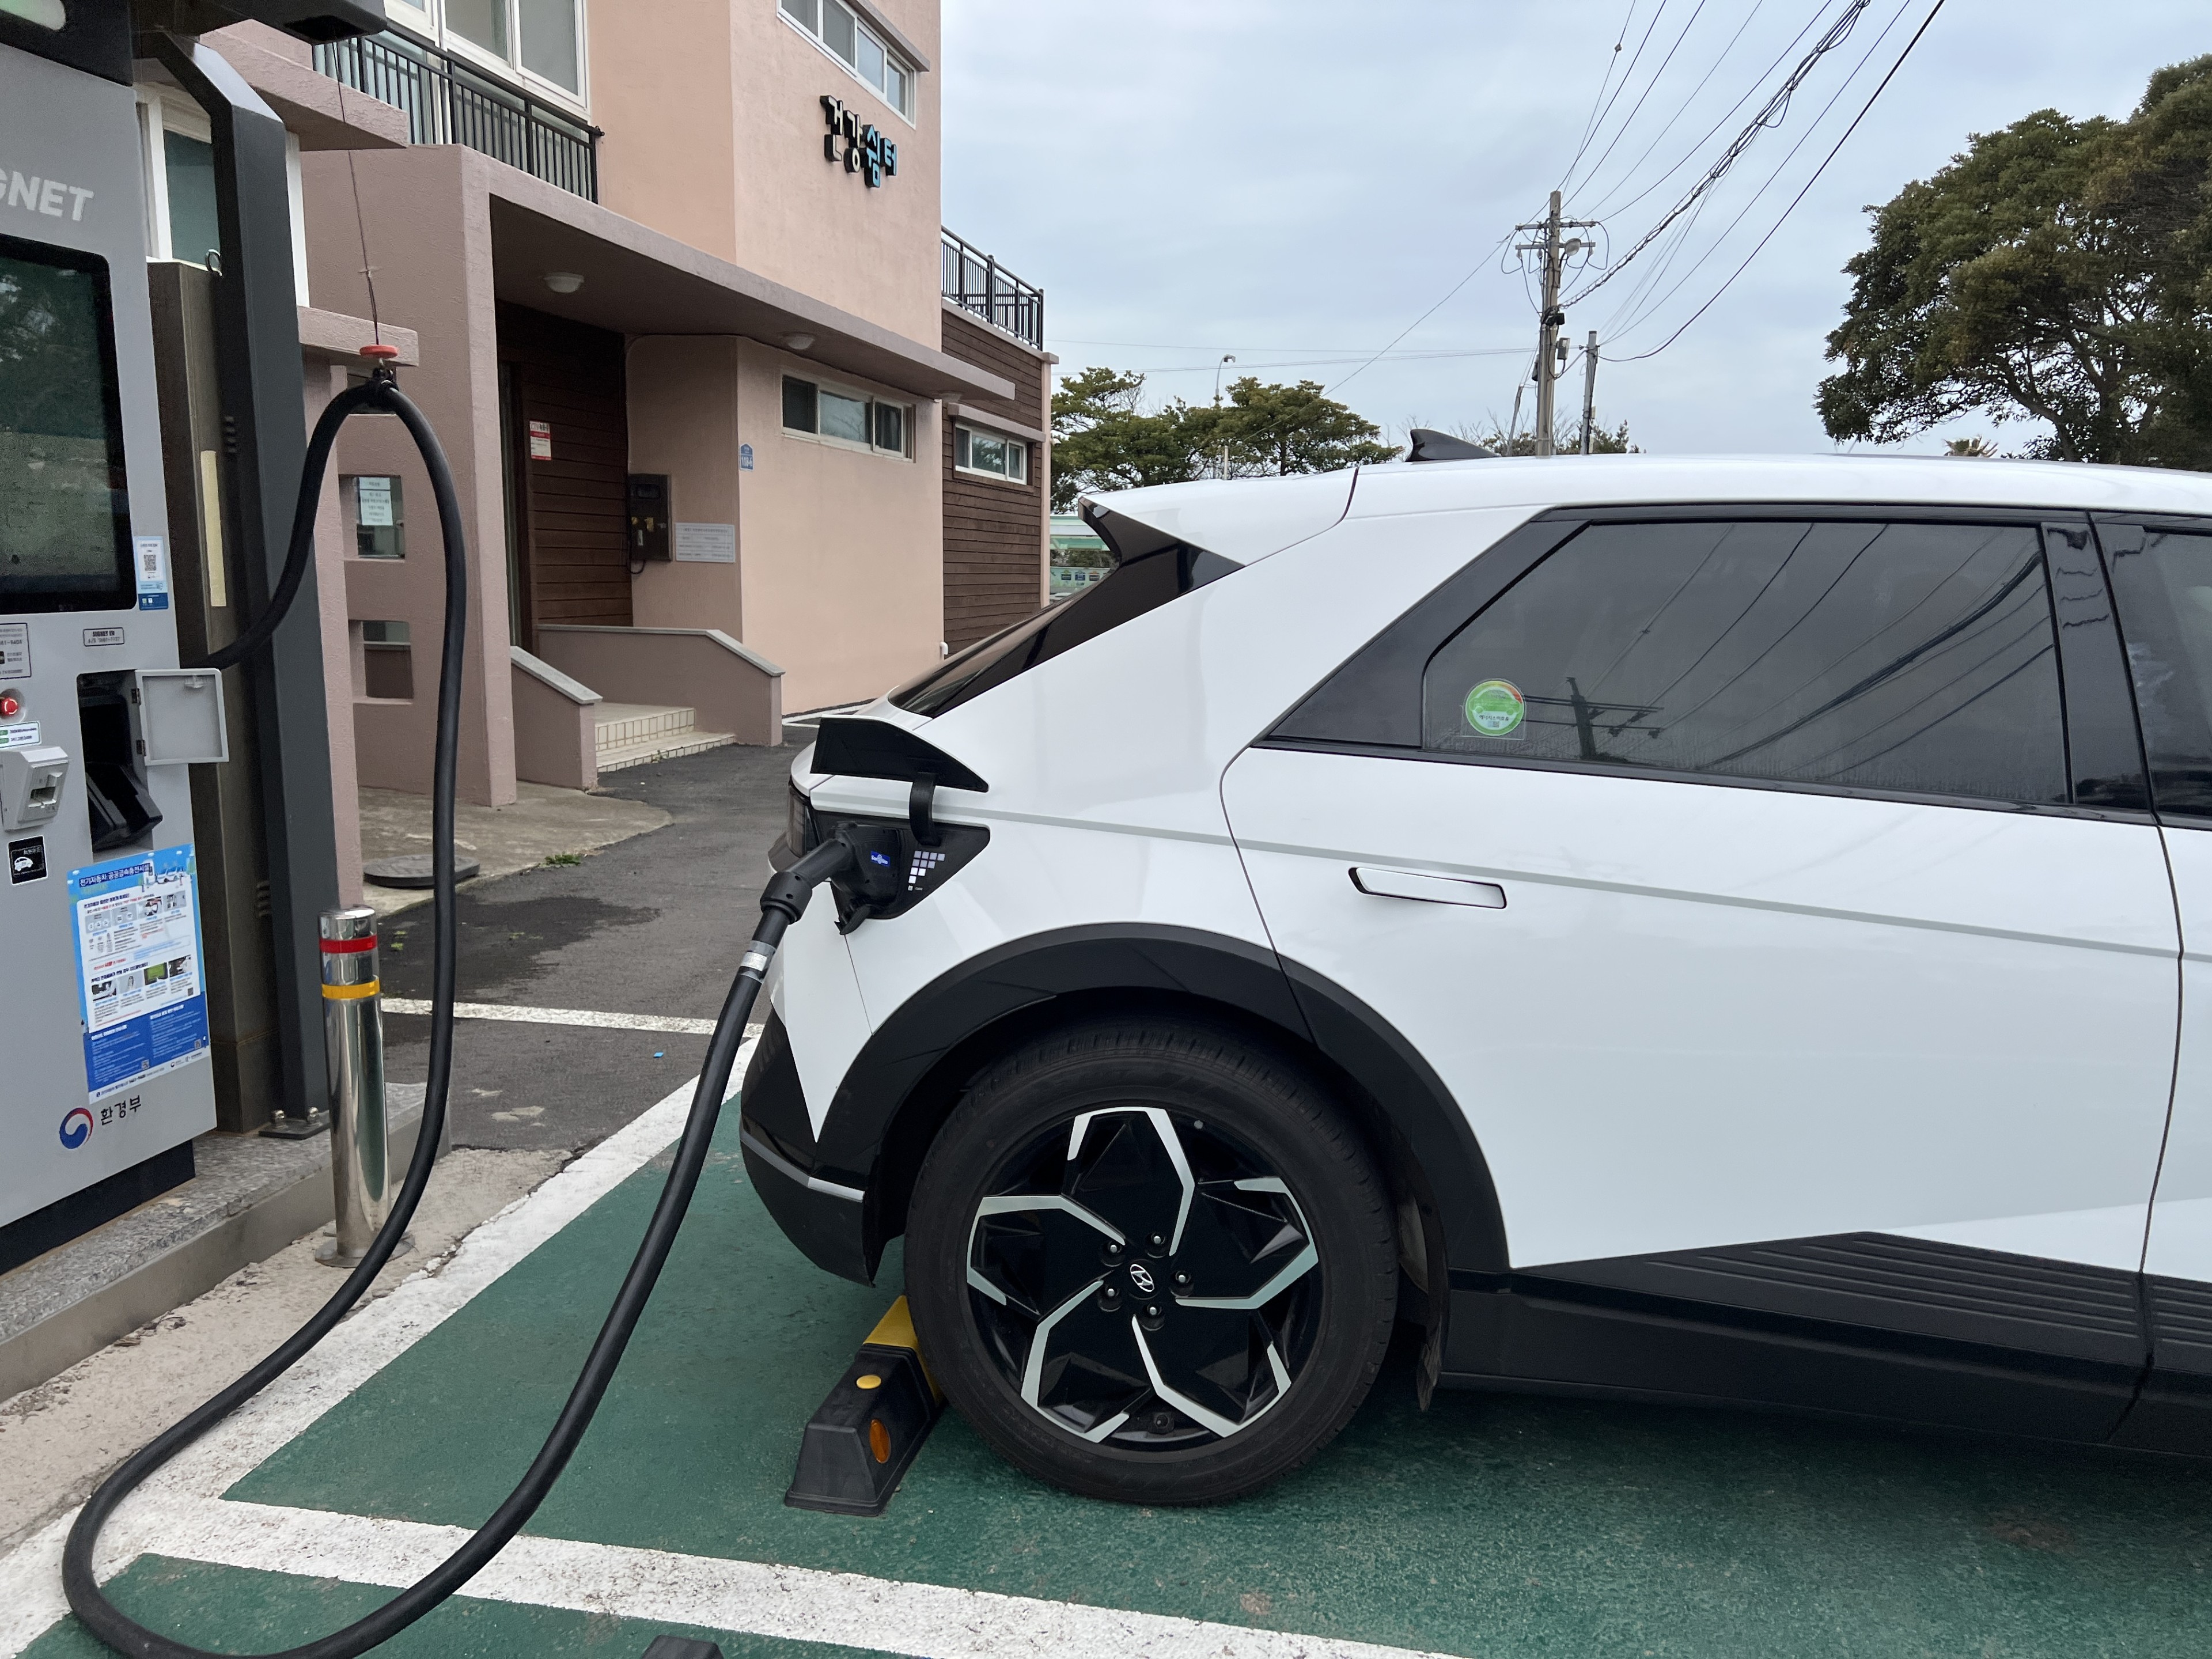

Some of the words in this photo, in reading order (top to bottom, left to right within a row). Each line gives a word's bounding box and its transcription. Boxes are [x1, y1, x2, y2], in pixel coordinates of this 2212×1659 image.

[0, 168, 95, 221] NET
[79, 874, 107, 887] 전기자동차
[100, 1094, 142, 1126] 환경부
